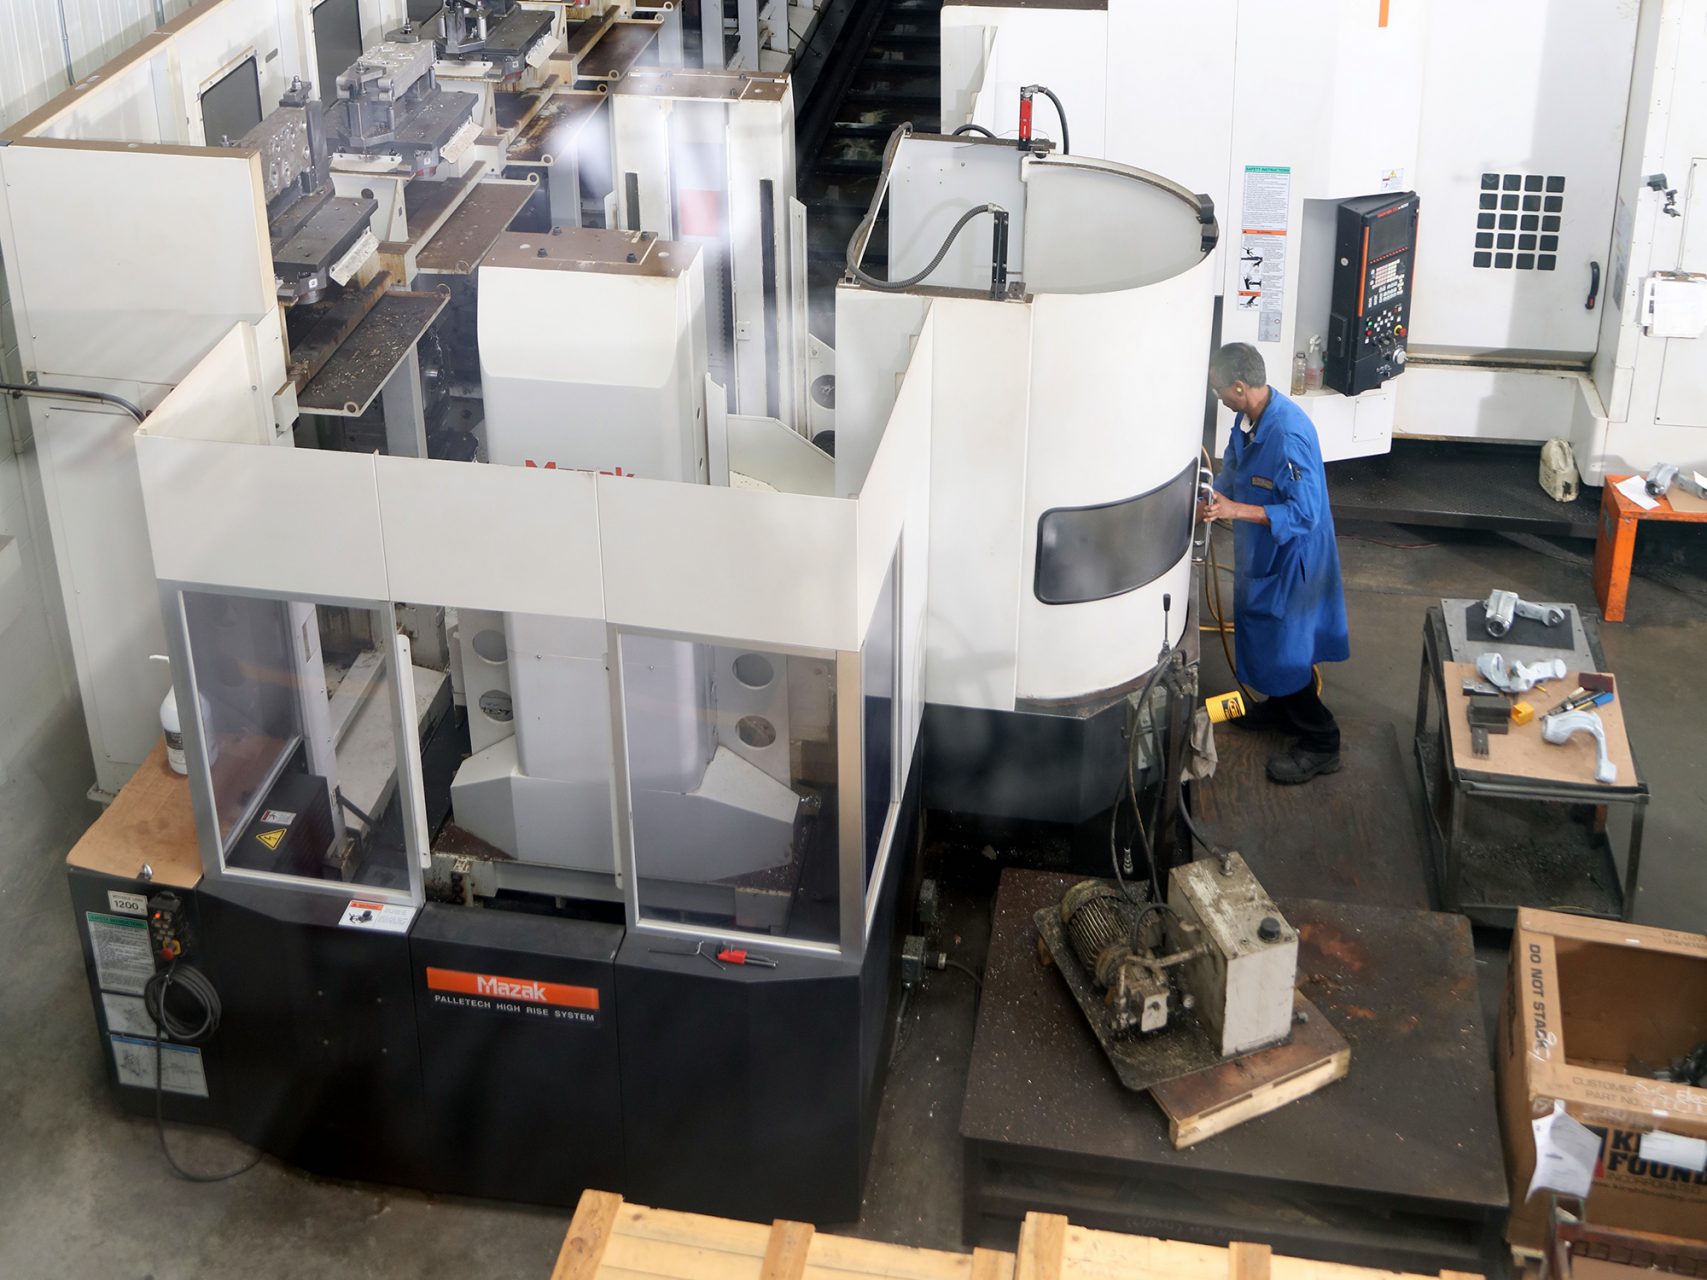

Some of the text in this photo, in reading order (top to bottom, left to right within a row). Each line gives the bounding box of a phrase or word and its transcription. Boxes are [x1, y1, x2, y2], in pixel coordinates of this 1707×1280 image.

[113, 900, 139, 910] 1200
[1529, 943, 1542, 964] DO
[477, 975, 548, 1002] Mazak
[1531, 967, 1544, 998] NOT
[434, 994, 595, 1022] PALLETECH HIGH RISE SYSTEM
[1533, 1001, 1548, 1050] STACK
